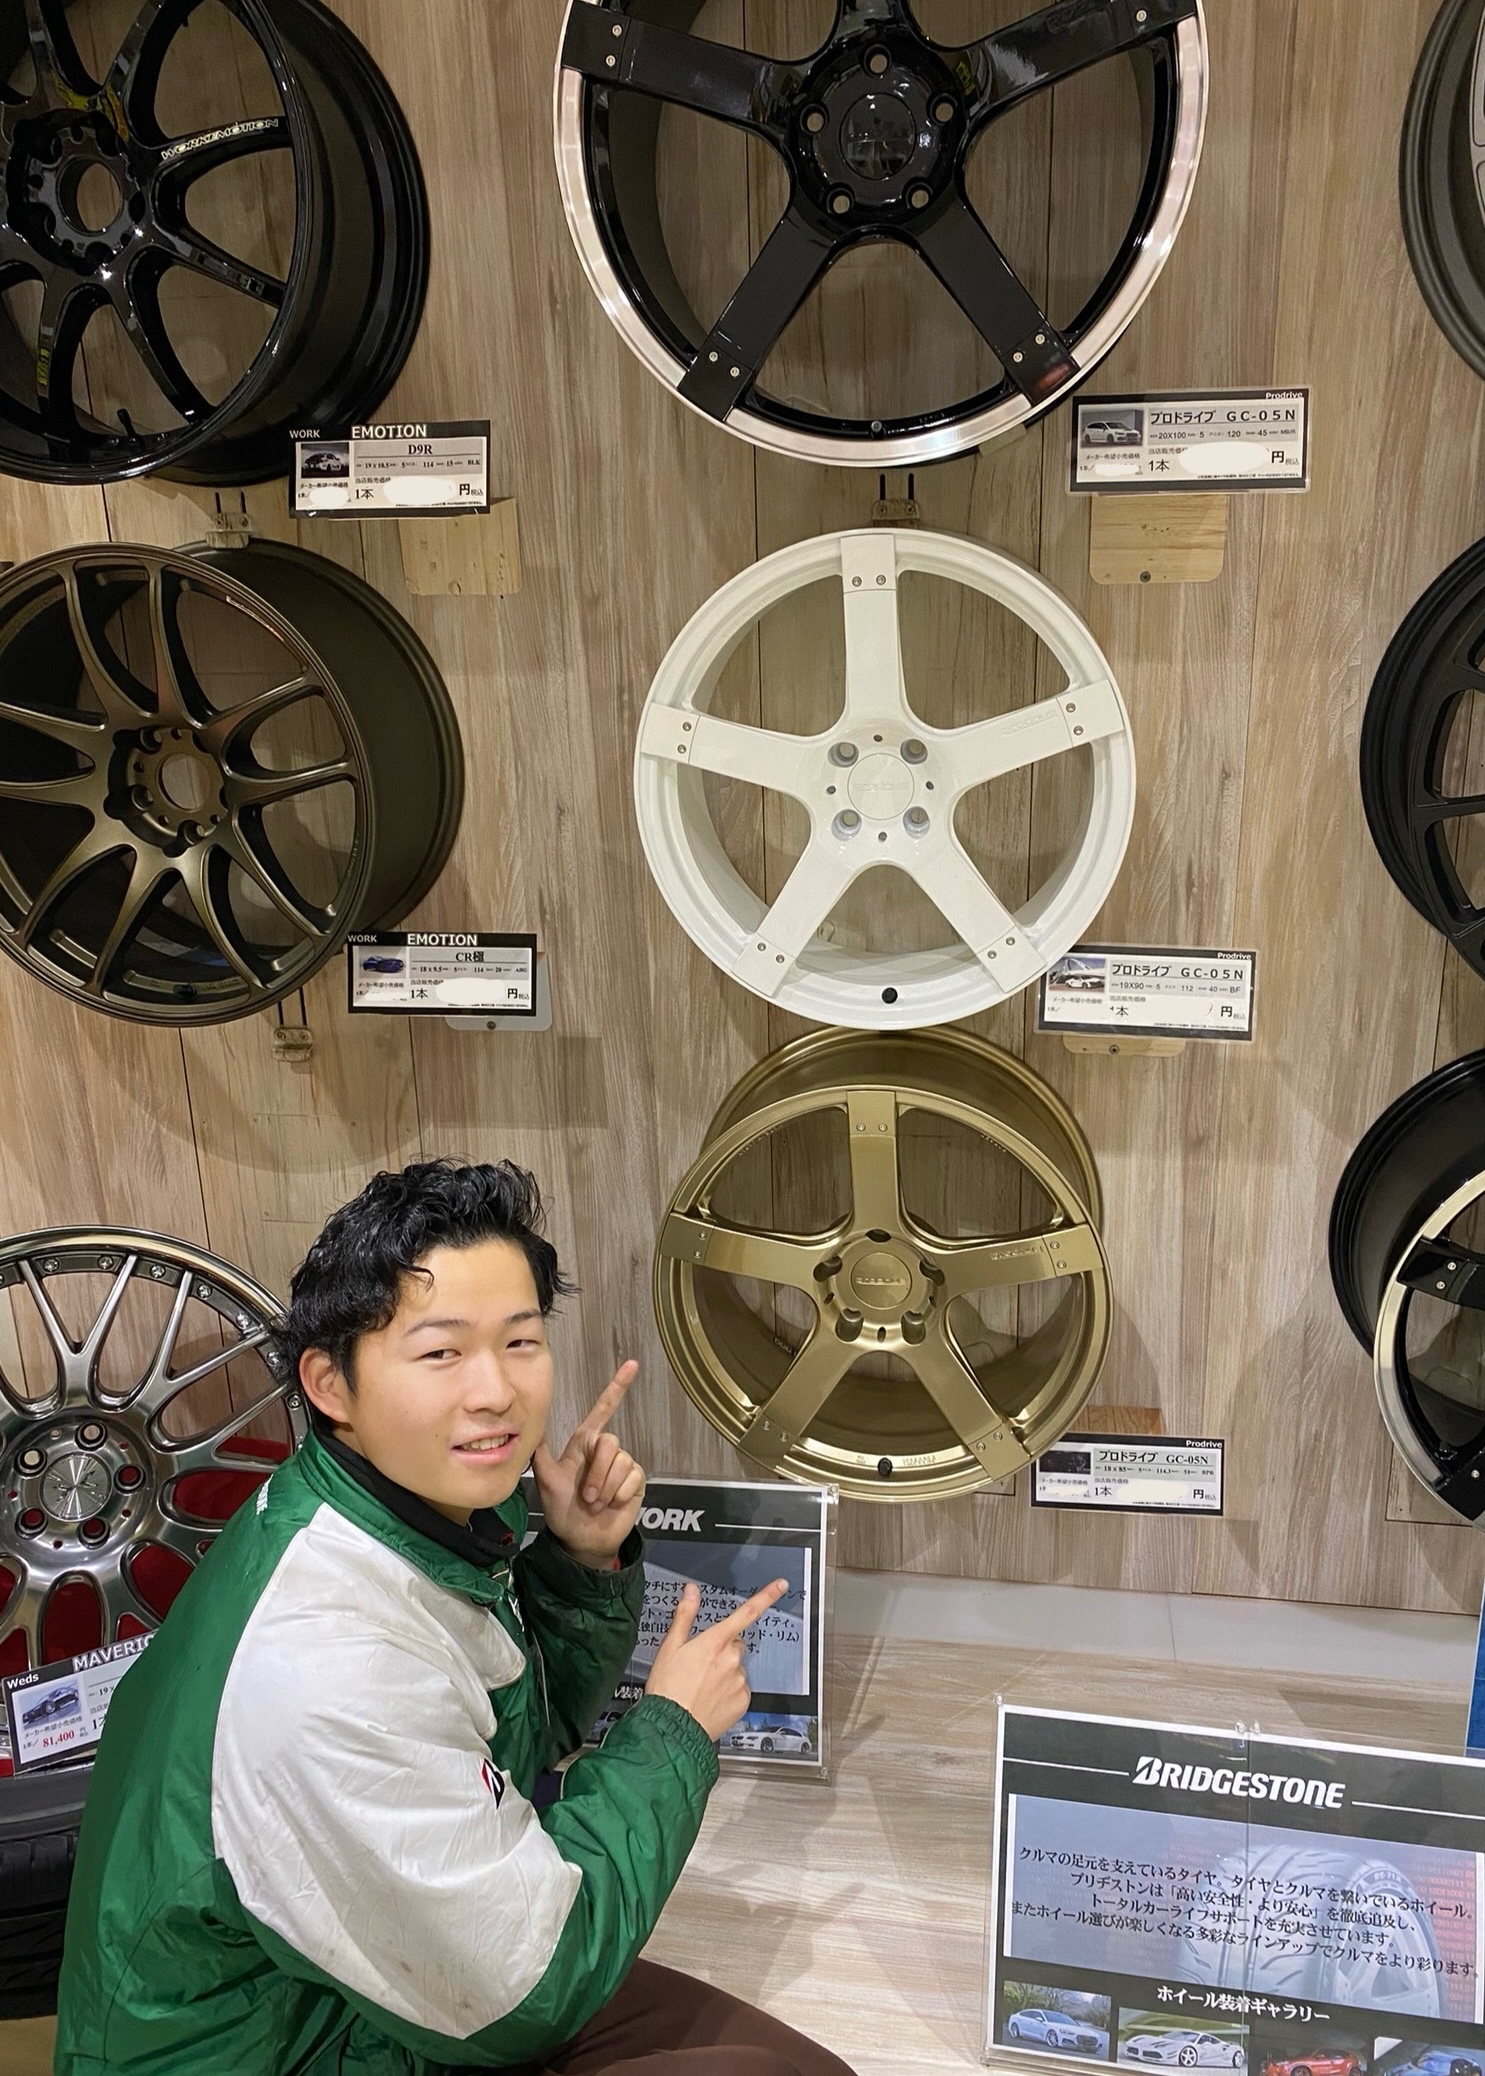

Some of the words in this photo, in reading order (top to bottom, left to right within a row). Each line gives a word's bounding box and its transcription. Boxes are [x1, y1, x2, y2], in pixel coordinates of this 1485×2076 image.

[1265, 391, 1303, 400] Prodrive
[1150, 410, 1216, 424] プロドライブ
[1227, 409, 1296, 422] GC-05N
[289, 429, 320, 439] WORK
[351, 424, 427, 439] EMOTION
[408, 444, 433, 456] D9R
[1271, 451, 1285, 464] 円
[1148, 459, 1170, 472] 1本
[355, 488, 374, 500] 1本
[459, 483, 470, 496] 円
[347, 934, 377, 943] WORK
[407, 933, 478, 946] EMOTION
[1217, 951, 1252, 960] Prodrive
[1112, 964, 1171, 977] プロドライブ
[1181, 967, 1244, 979] GC-05N
[411, 988, 428, 999] 1本
[507, 988, 518, 999] 円
[1220, 1006, 1233, 1017] 円
[1185, 1439, 1223, 1448] Prodrive
[1099, 1451, 1158, 1463] プロドライブ
[1166, 1454, 1209, 1465] GC-05N
[1095, 1485, 1112, 1496] 1本
[1193, 1489, 1204, 1499] 円
[6, 1672, 40, 1690] Weds
[42, 1730, 75, 1748] 81,400
[1132, 1755, 1346, 1809] BRIDGESTONE
[1157, 1985, 1330, 2022] ホイール装着ギャラリー
